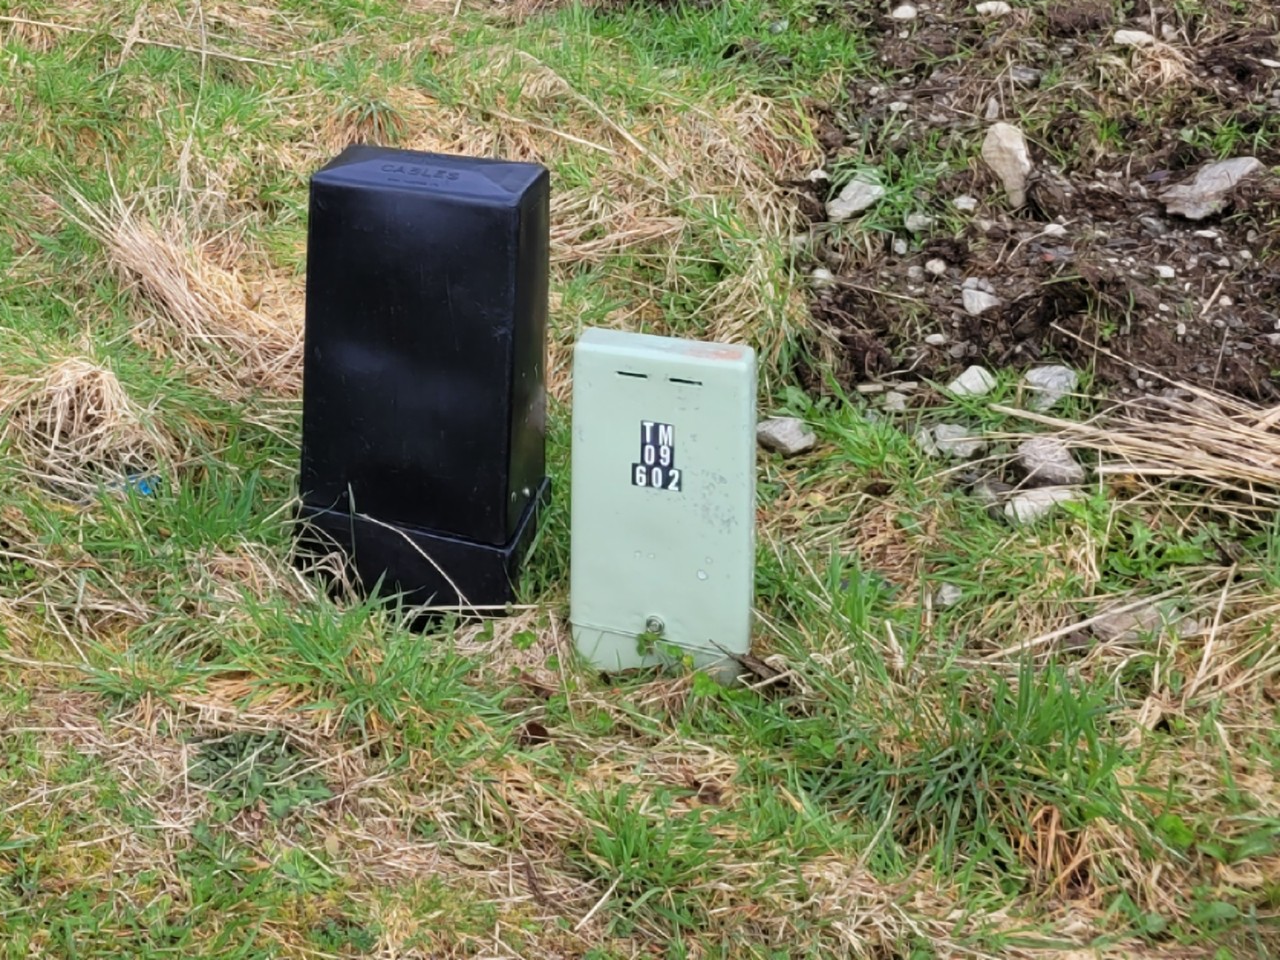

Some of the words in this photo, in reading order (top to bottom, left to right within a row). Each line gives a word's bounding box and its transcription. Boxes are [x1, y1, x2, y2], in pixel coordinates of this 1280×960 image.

[381, 164, 459, 181] CABLES
[642, 421, 673, 447] TM
[644, 444, 671, 467] 09
[635, 465, 680, 491] 602
